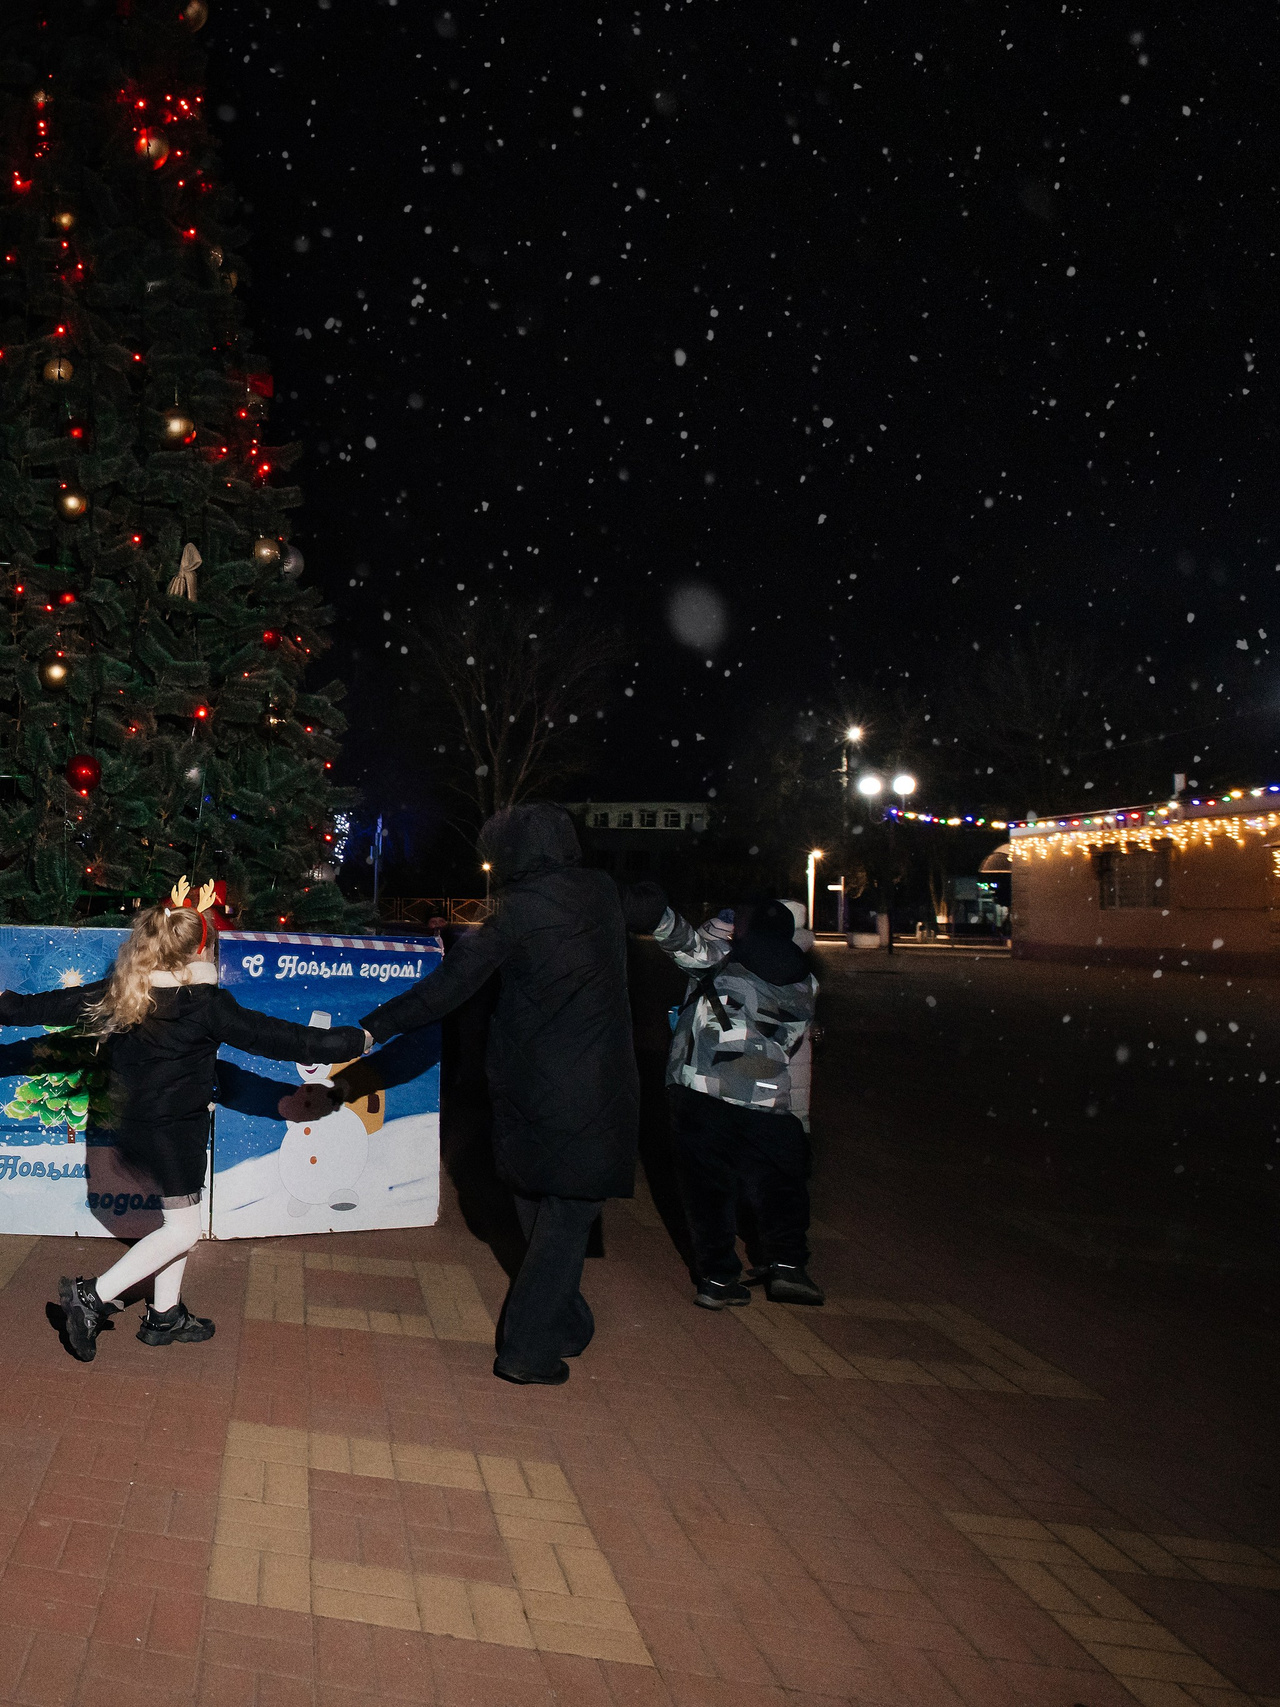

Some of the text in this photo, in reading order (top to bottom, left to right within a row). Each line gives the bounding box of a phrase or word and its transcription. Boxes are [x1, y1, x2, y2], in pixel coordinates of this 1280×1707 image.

[242, 953, 423, 982] С Новым годом!
